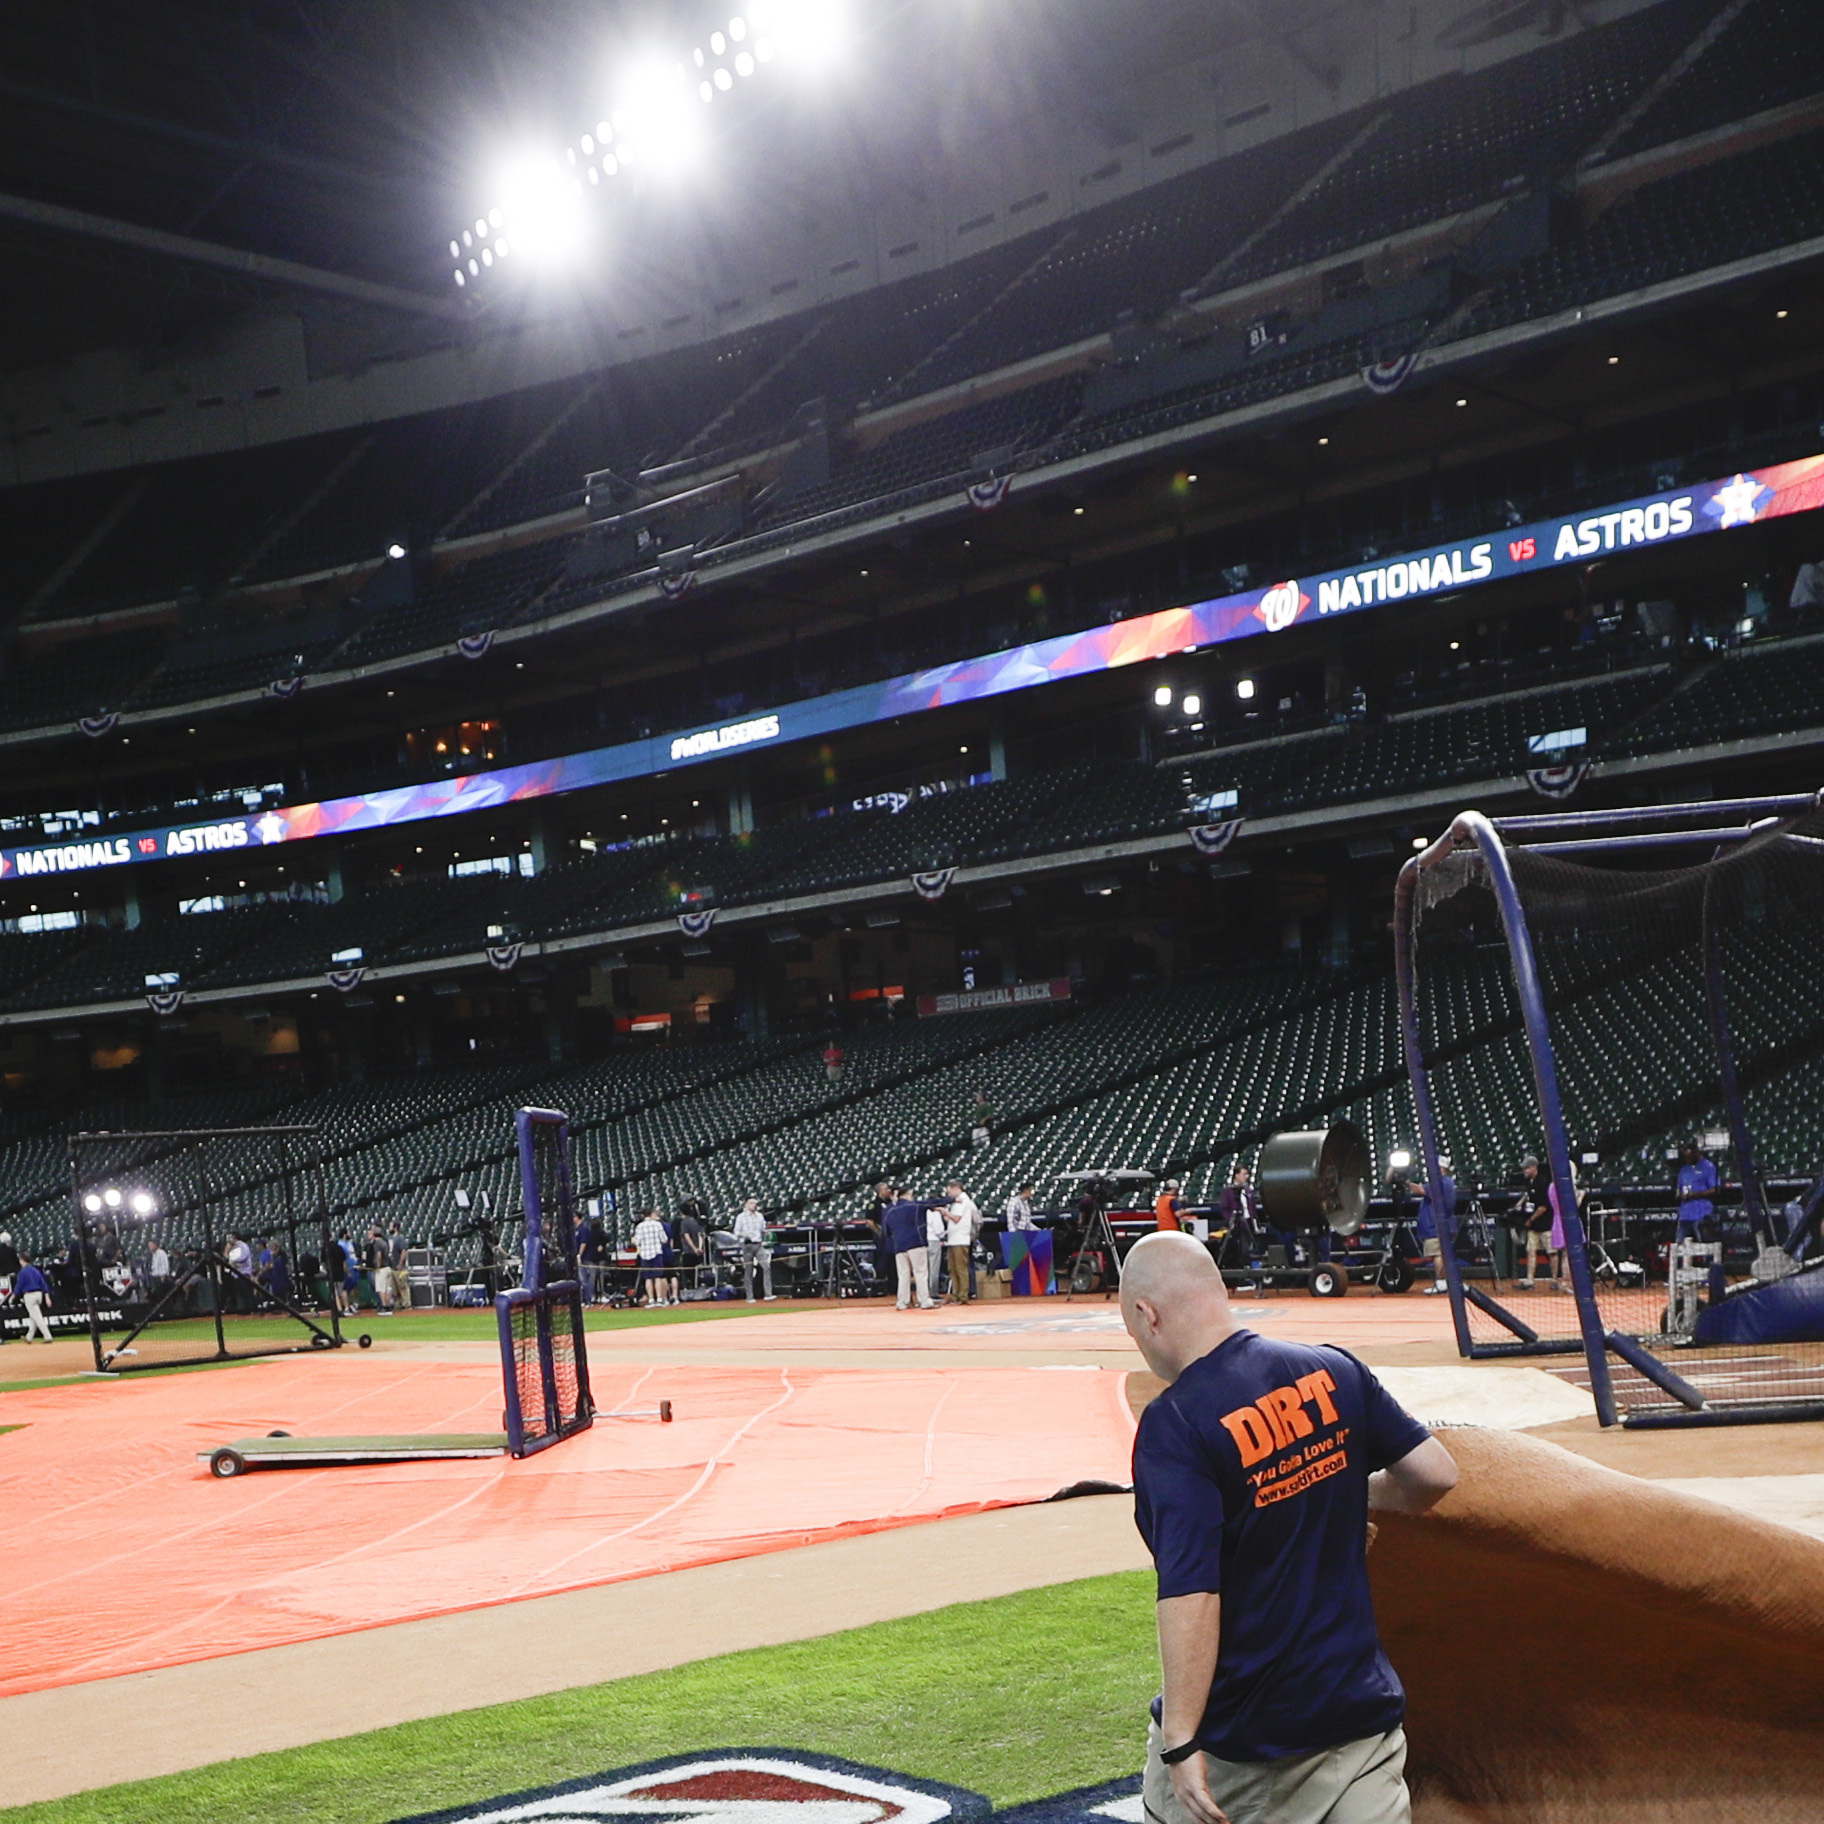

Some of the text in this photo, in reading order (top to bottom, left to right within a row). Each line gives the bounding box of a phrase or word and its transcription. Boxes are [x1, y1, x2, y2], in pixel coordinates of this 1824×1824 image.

[1318, 543, 1493, 615] NATIONALS
[1508, 538, 1537, 562] VS
[1553, 496, 1694, 561] ASTROS
[15, 838, 132, 876] NATIONALS
[165, 821, 249, 856] ASTROS
[959, 987, 1013, 1009] OFFICIAL
[1013, 982, 1052, 1001] BRICK
[1219, 1368, 1340, 1468] DIRT
[1304, 1436, 1334, 1462] Love
